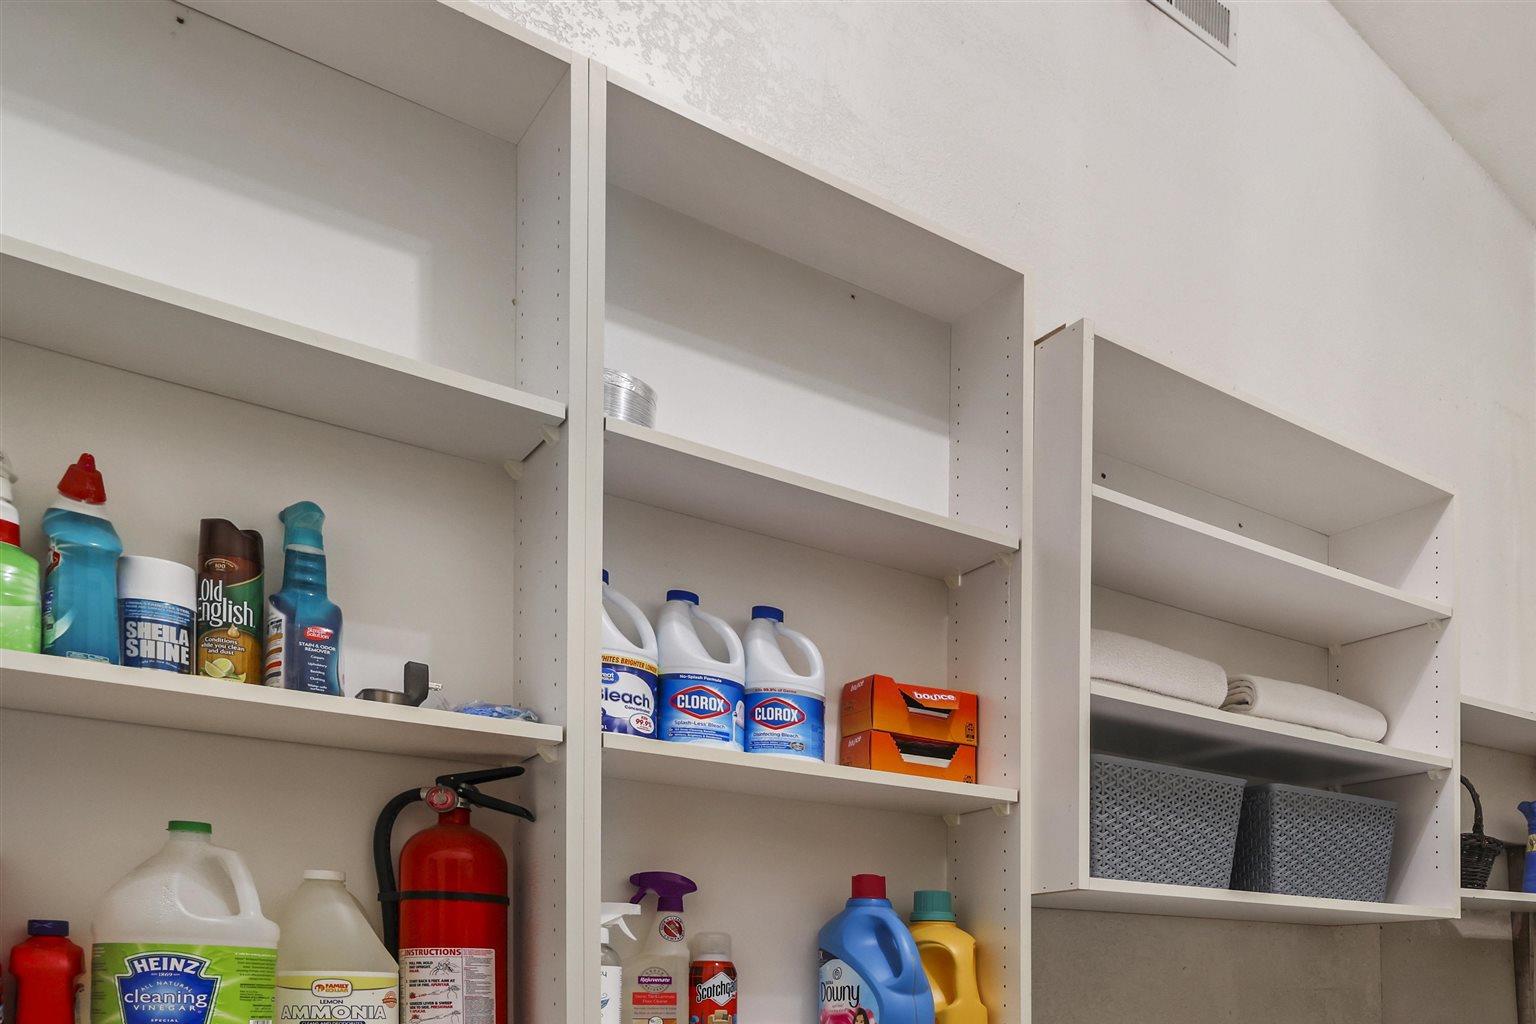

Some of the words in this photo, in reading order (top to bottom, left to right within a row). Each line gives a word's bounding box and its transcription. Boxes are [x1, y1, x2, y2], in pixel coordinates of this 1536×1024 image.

[200, 578, 223, 602] Old
[126, 620, 190, 647] SHEILA
[204, 636, 238, 645] Conditions
[125, 639, 190, 665] SHINE
[214, 643, 227, 651] you
[227, 644, 245, 652] clean
[305, 647, 331, 655] REMOVER
[320, 644, 336, 652] ODOR
[620, 657, 645, 669] BRIGHTER
[913, 691, 956, 701] bounce
[676, 694, 725, 712] CLOROX
[755, 707, 798, 722] CLOROX
[635, 718, 652, 728] 99.9%
[404, 948, 462, 956] INSTRUCTIONS
[132, 957, 200, 975] HEINZ
[140, 984, 153, 993] ALL
[156, 981, 193, 993] NATURAL
[124, 988, 208, 1008] cleaning
[821, 981, 860, 1007] Downy
[281, 1005, 387, 1020] AMMONIA
